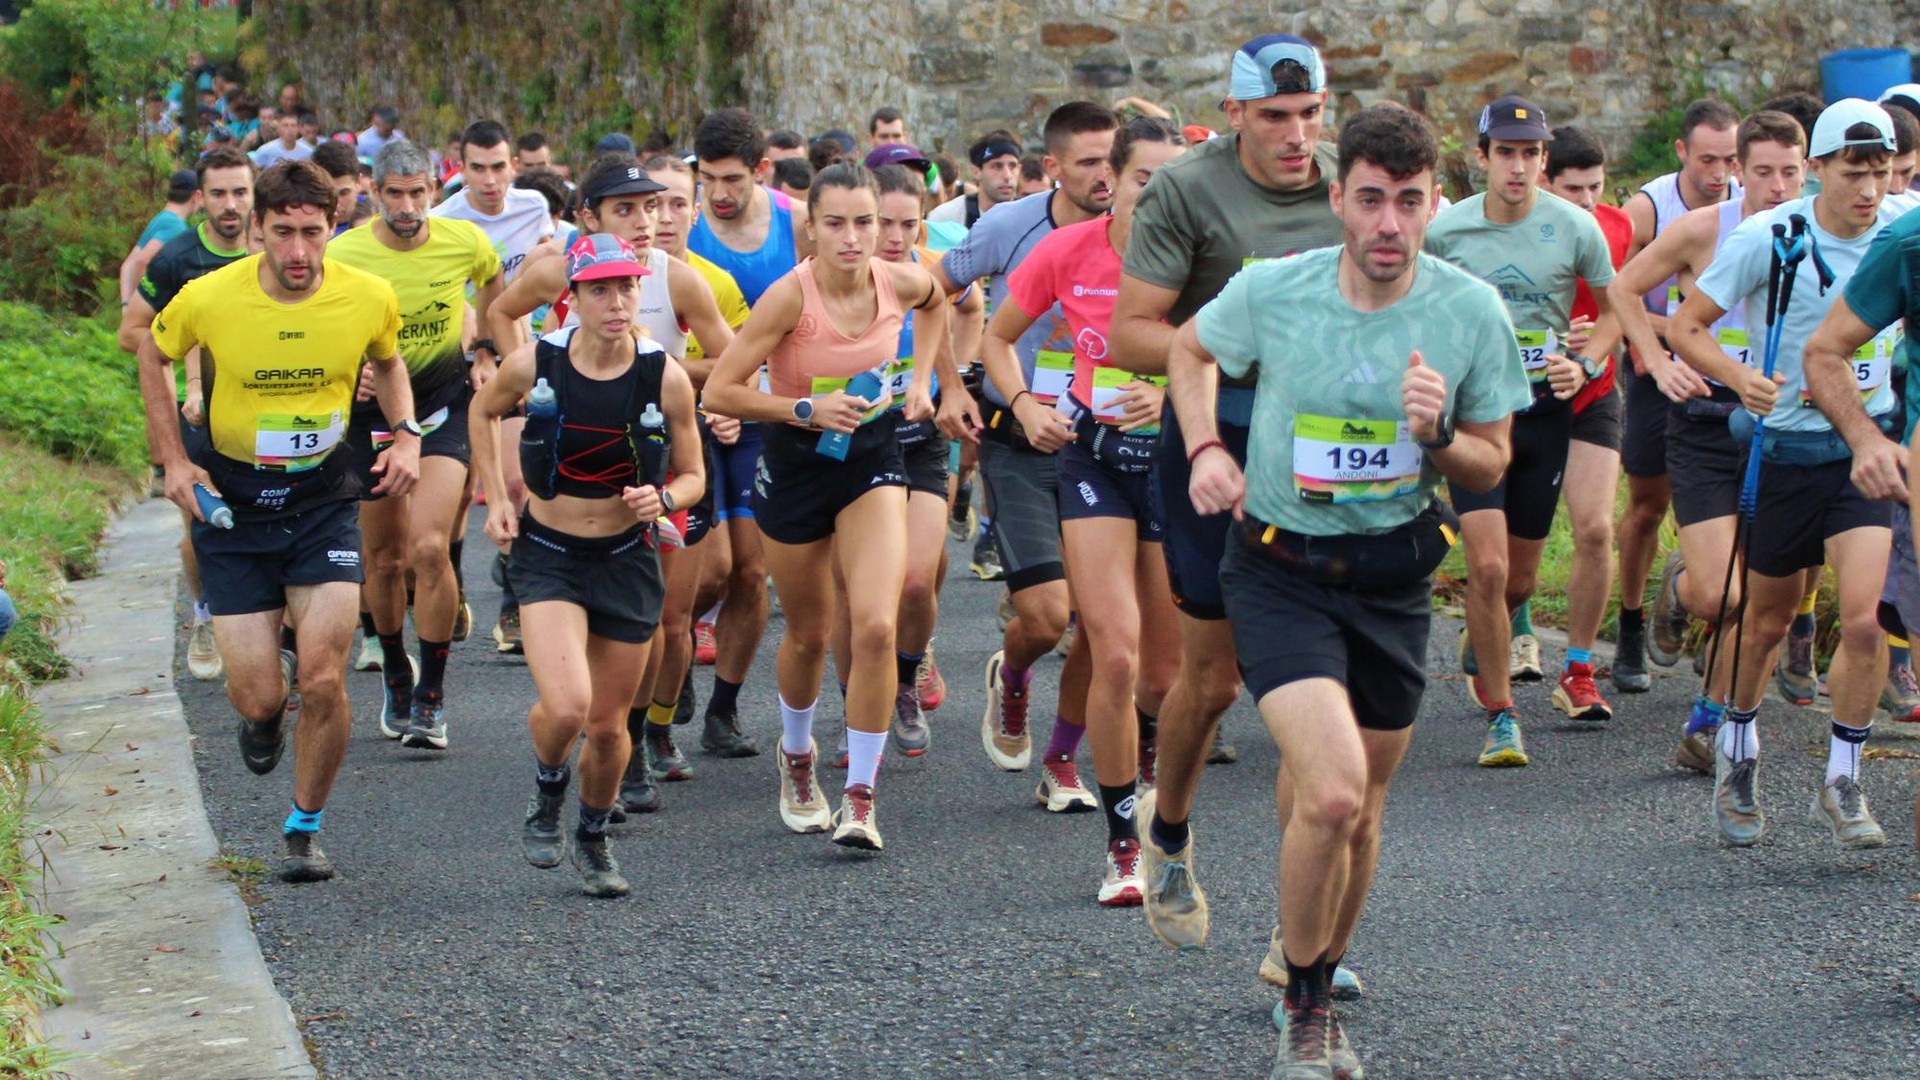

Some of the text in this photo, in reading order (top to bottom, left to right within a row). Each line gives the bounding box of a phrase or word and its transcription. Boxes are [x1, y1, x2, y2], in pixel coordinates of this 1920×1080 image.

[1738, 349, 1754, 364] 1
[254, 368, 324, 380] GAIKAR
[1853, 363, 1870, 381] 5
[290, 433, 319, 450] 13
[1326, 447, 1390, 470] 194
[1335, 470, 1378, 479] ANDONI
[260, 487, 291, 497] COMP
